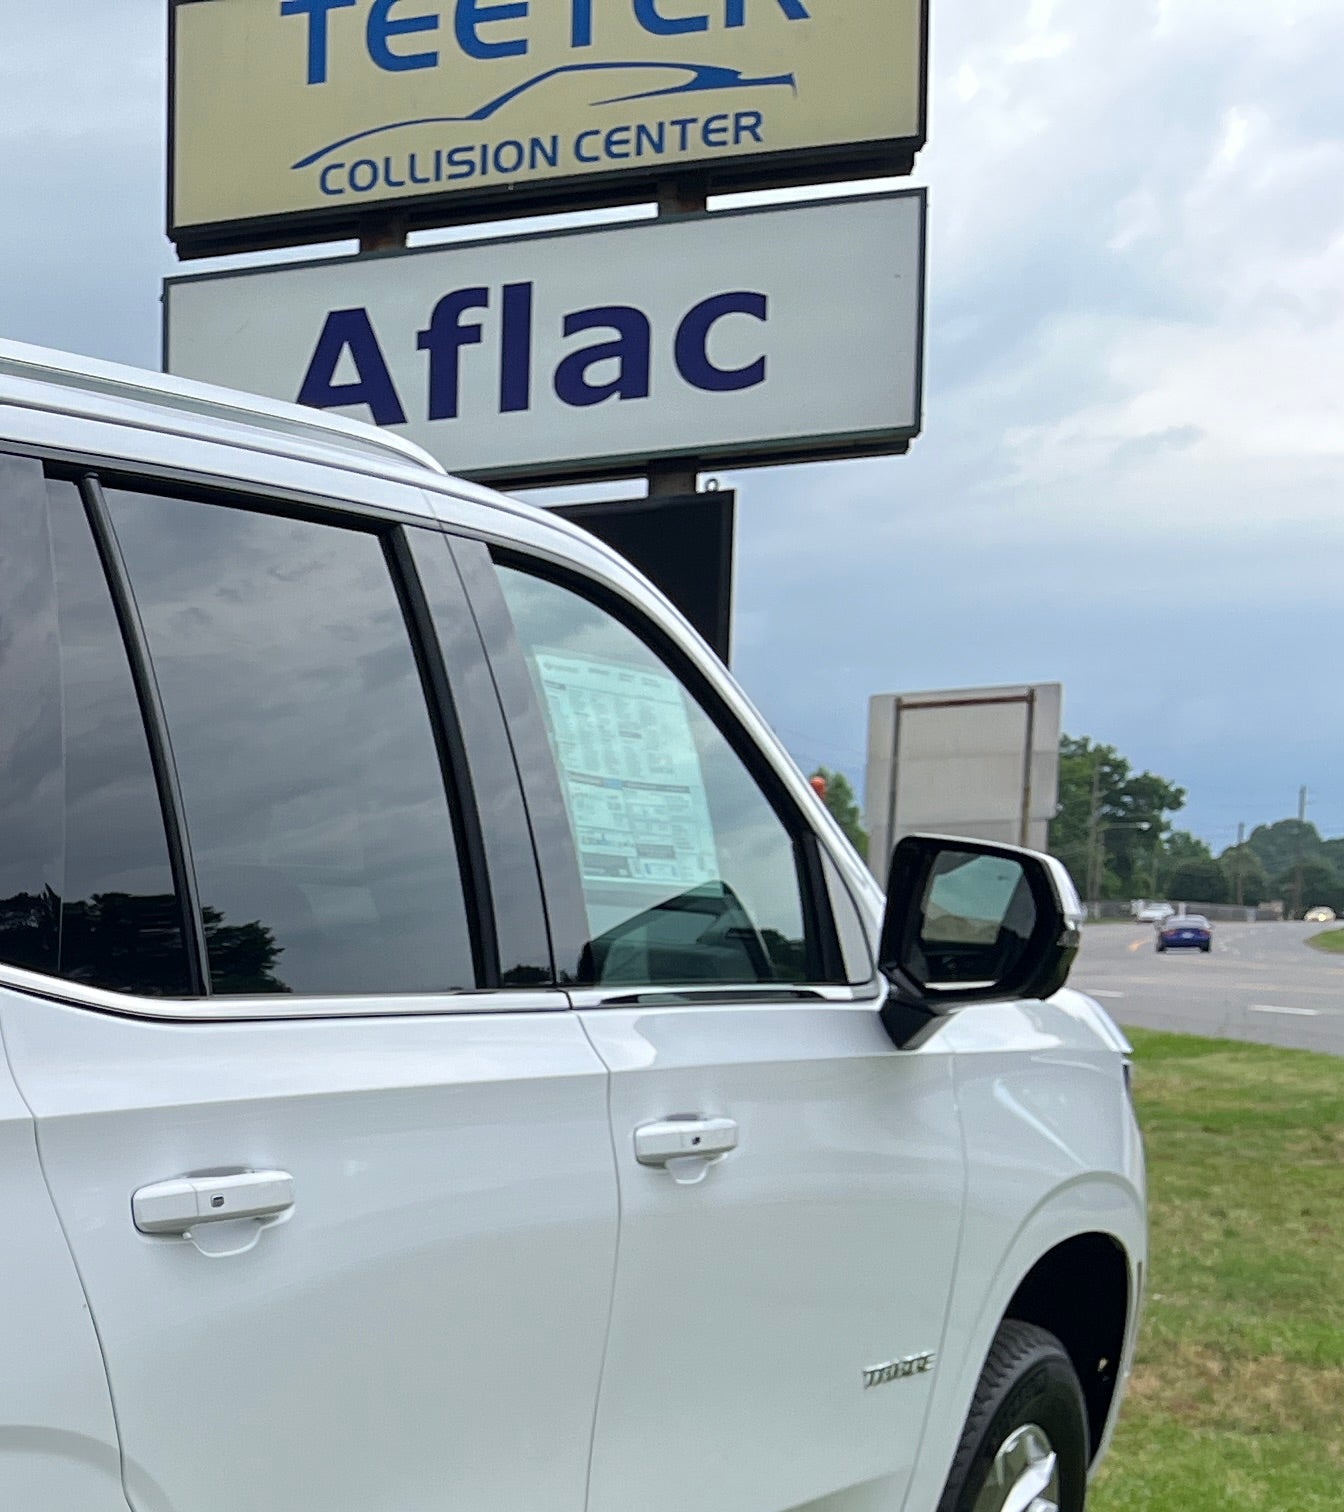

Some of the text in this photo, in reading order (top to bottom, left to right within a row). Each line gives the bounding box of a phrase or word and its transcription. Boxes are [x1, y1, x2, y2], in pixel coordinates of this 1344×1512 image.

[319, 110, 764, 196] COLLISION CENTER
[293, 280, 768, 426] Aflac
